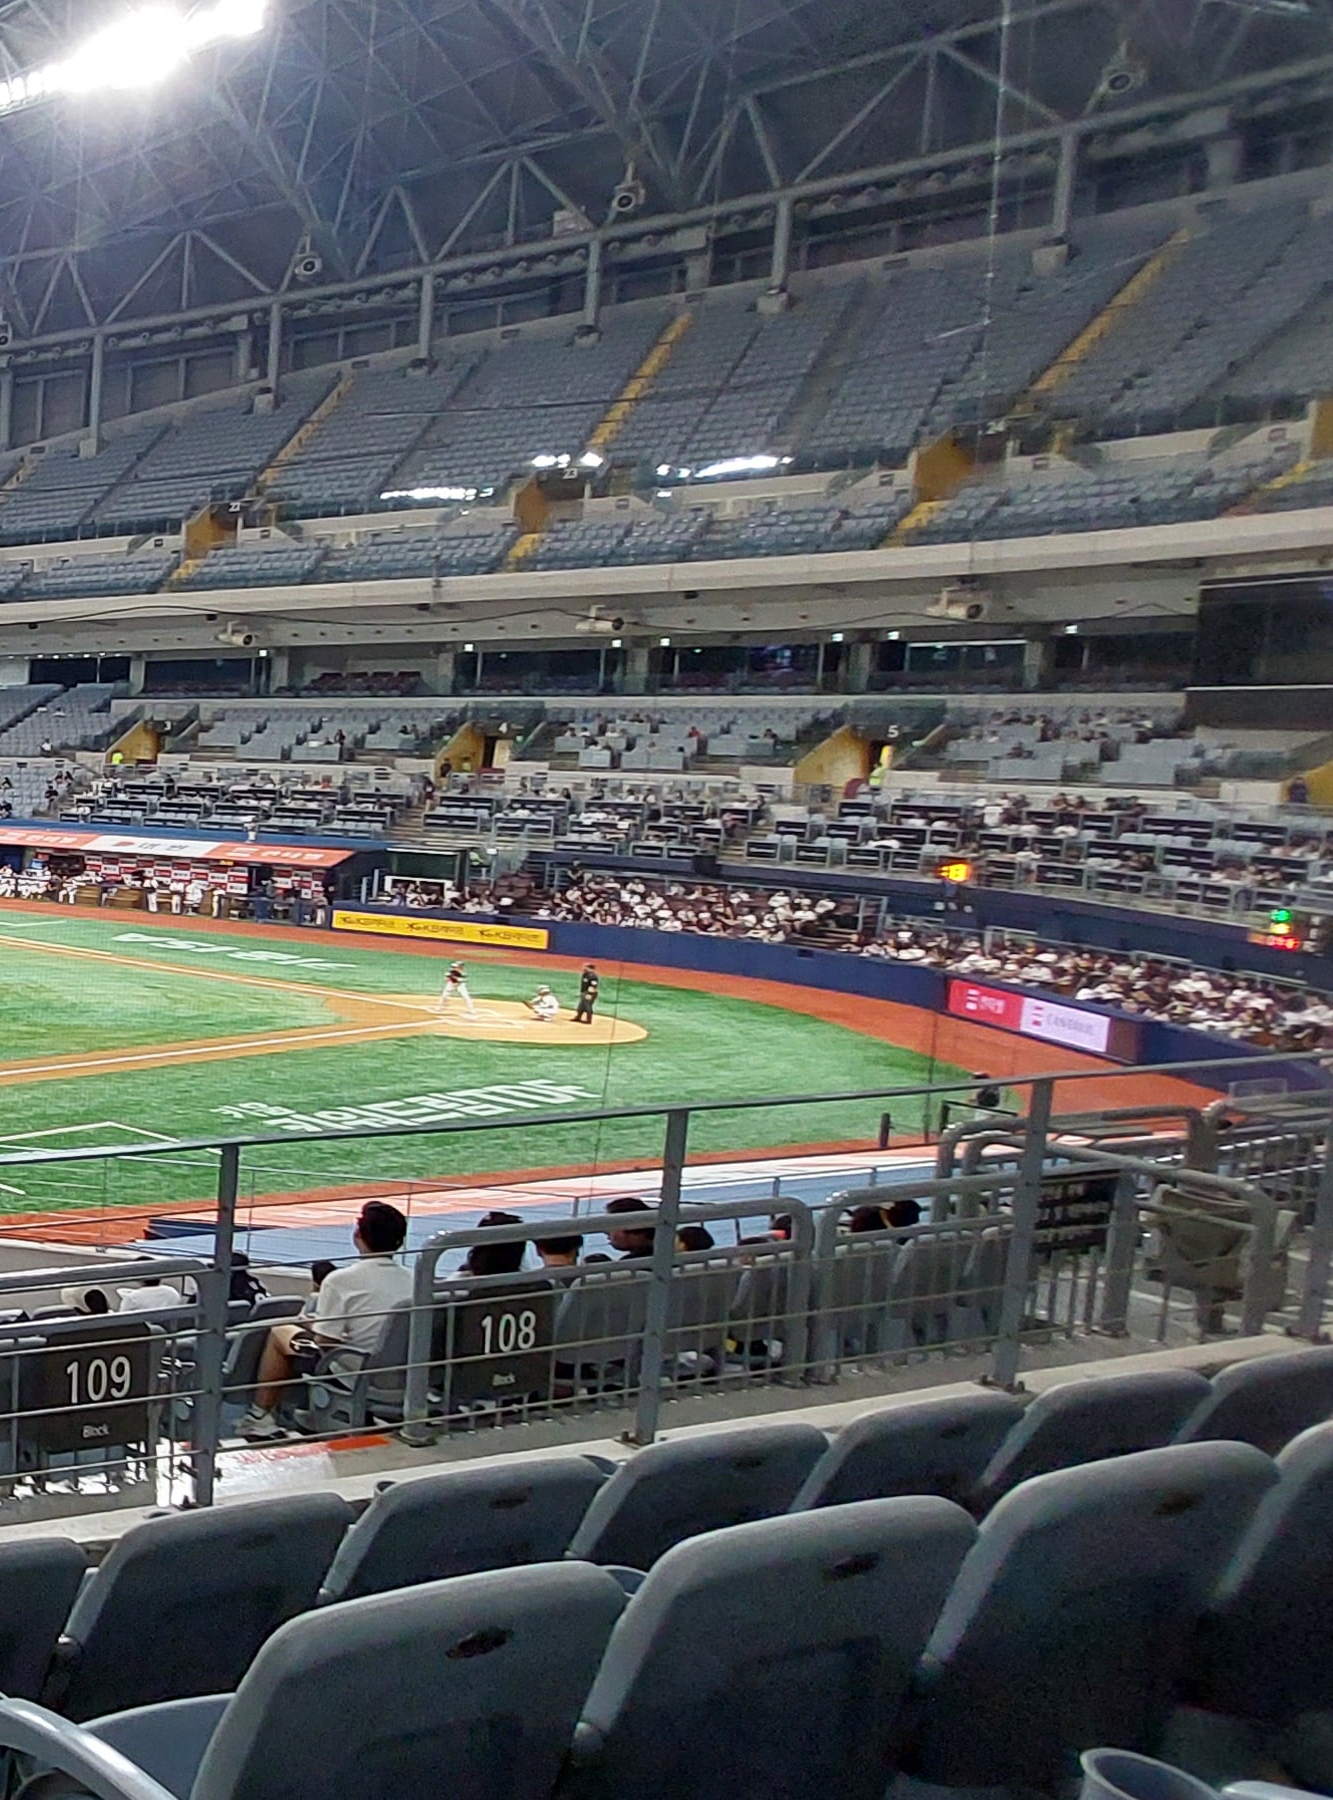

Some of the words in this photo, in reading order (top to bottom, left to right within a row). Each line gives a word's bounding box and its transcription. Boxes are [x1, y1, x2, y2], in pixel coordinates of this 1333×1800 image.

[887, 725, 899, 738] 5
[481, 1311, 536, 1354] 108
[67, 1356, 131, 1404] 109
[83, 1423, 110, 1438] Block
